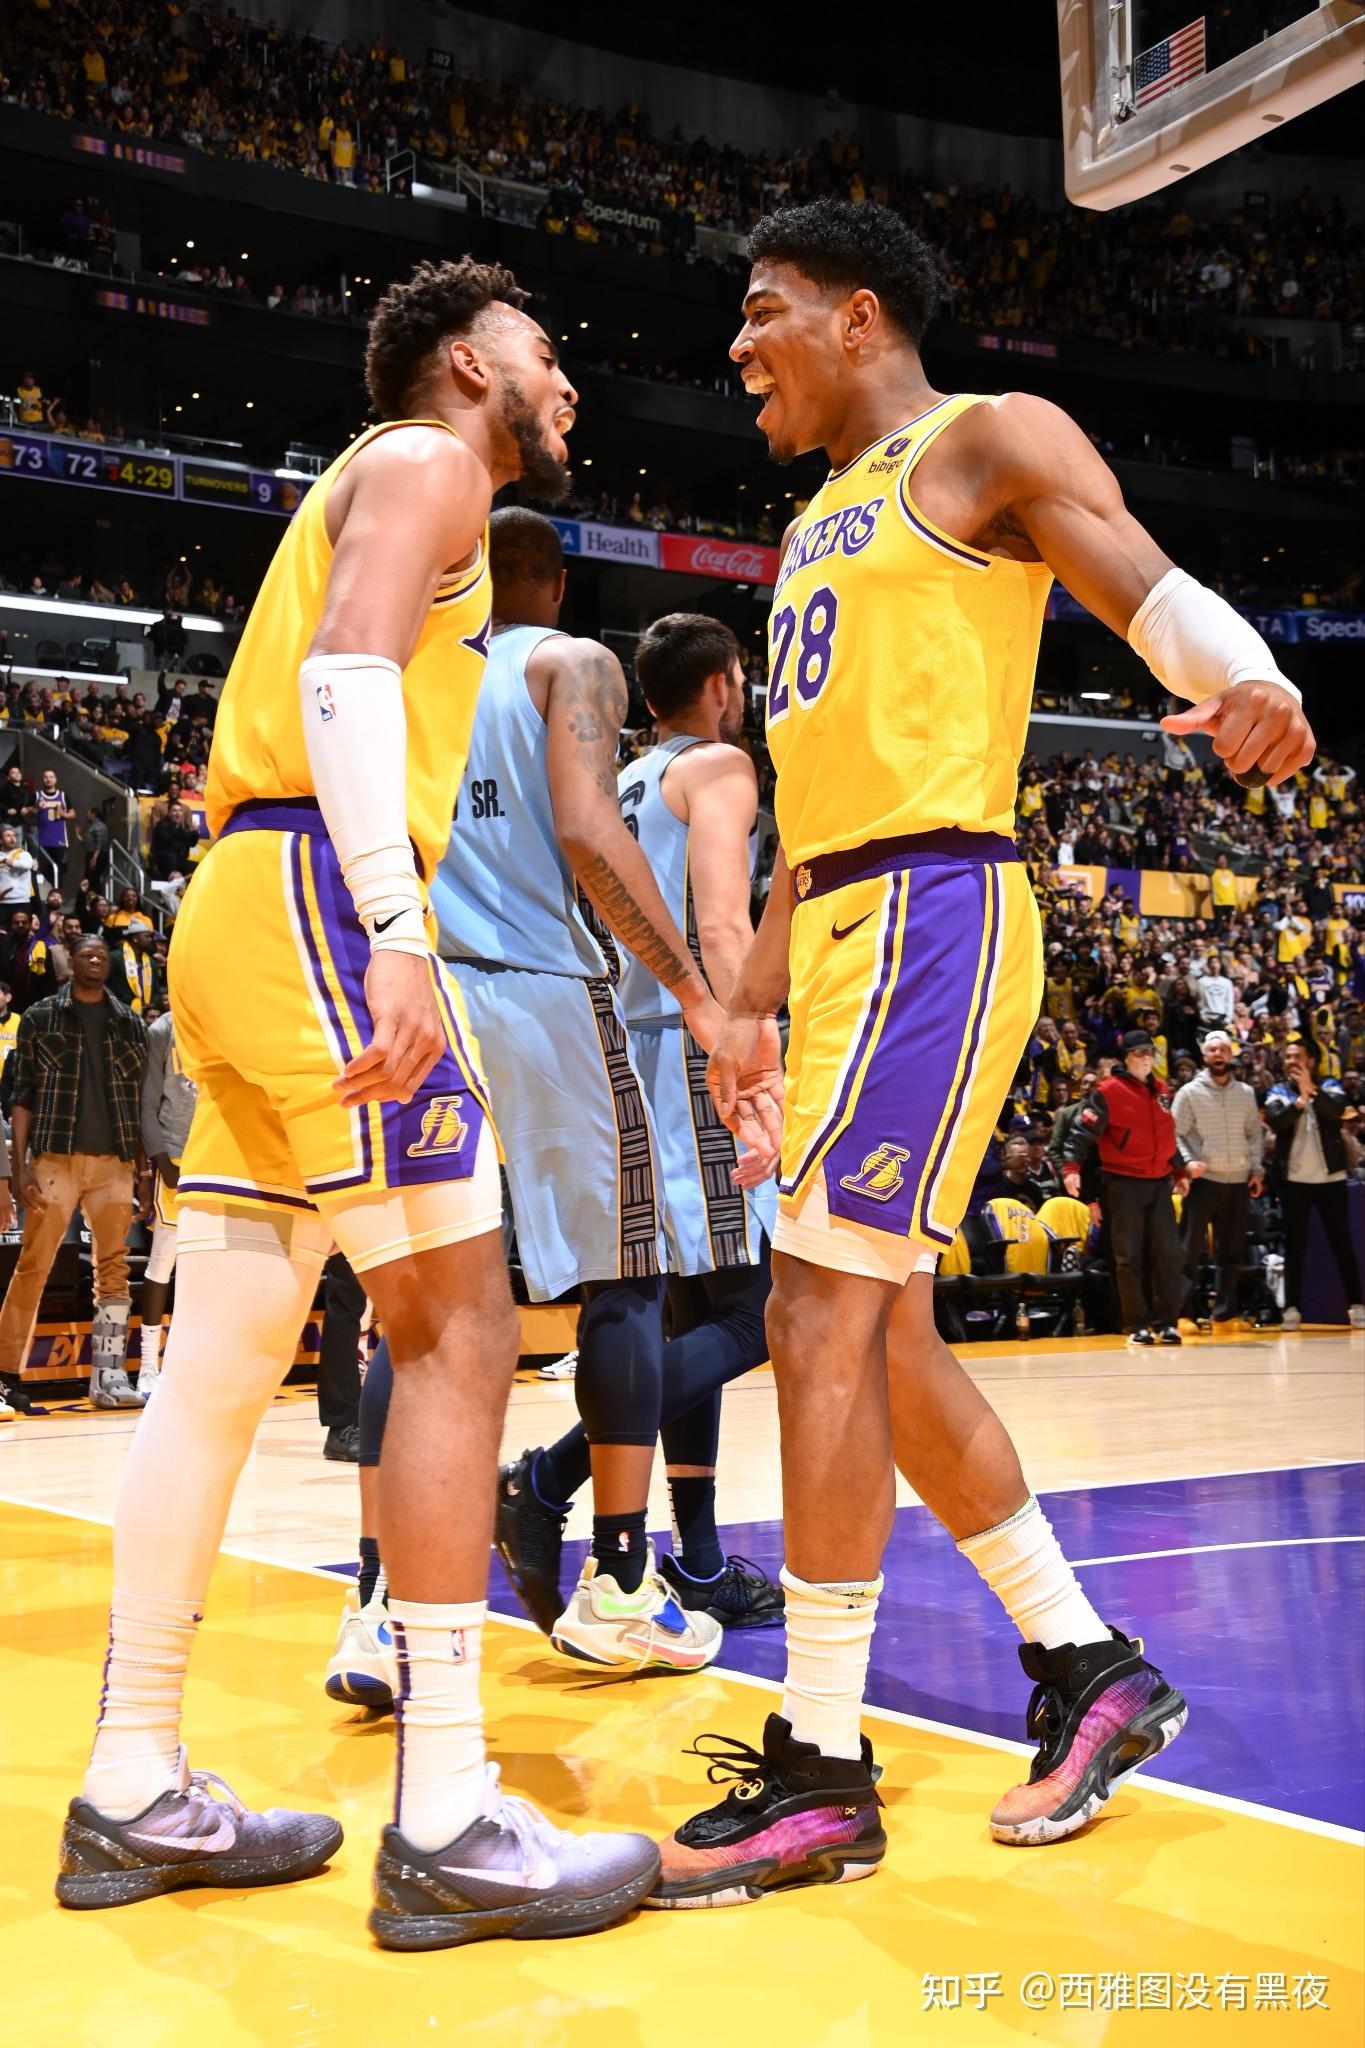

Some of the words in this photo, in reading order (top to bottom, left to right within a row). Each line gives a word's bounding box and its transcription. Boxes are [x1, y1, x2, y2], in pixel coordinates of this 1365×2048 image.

[582, 199, 661, 232] Spectrum
[12, 444, 43, 469] 73
[67, 453, 97, 478] 72
[120, 462, 173, 489] 4:29
[868, 458, 904, 474] bibigo
[258, 483, 272, 503] 9
[586, 530, 650, 559] Health
[768, 585, 838, 721] 28
[471, 778, 506, 819] SR.
[580, 852, 691, 989] REDEMPTION
